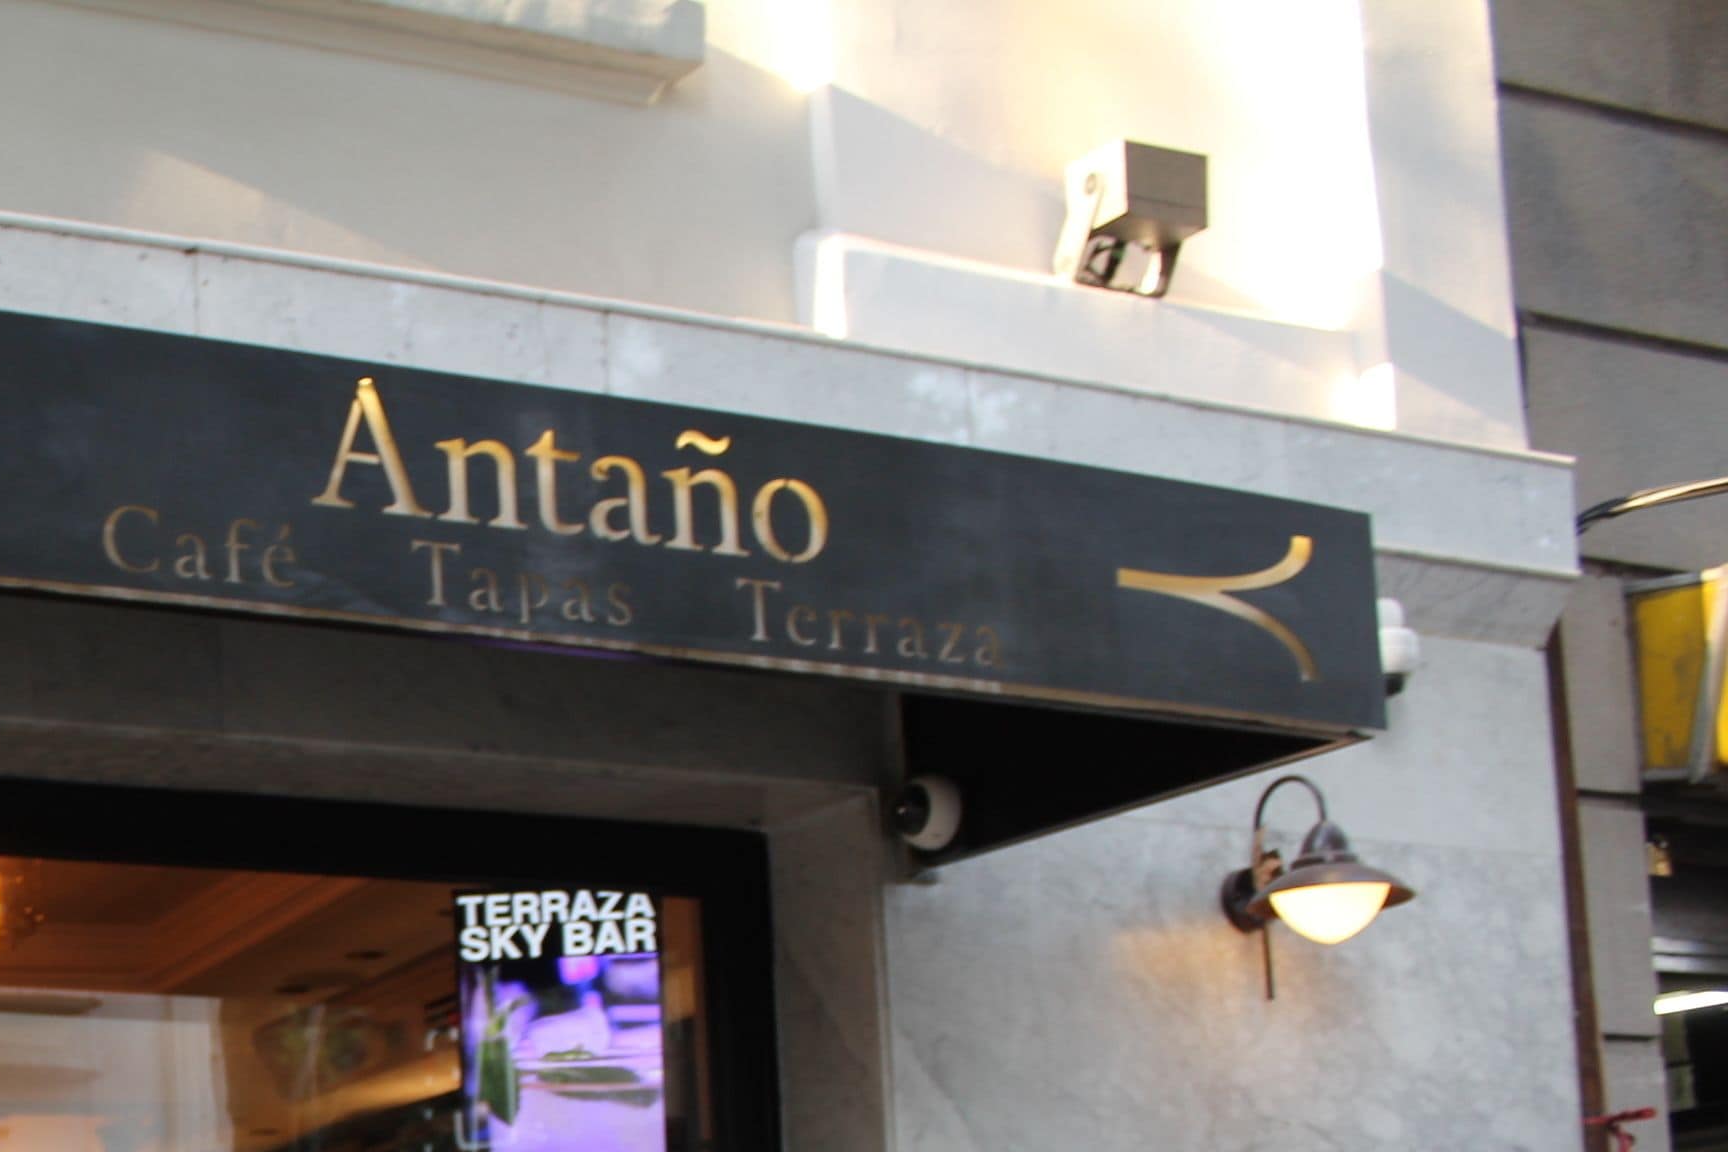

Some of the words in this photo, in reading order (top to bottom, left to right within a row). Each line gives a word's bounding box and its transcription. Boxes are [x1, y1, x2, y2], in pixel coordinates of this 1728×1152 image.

[312, 377, 828, 564] Antaño
[101, 505, 296, 589] Café
[410, 540, 634, 627] Tapas
[734, 577, 1005, 670] Terraza
[456, 890, 656, 926] TERRAZA
[459, 924, 550, 962] SKY
[563, 918, 657, 956] BAR
